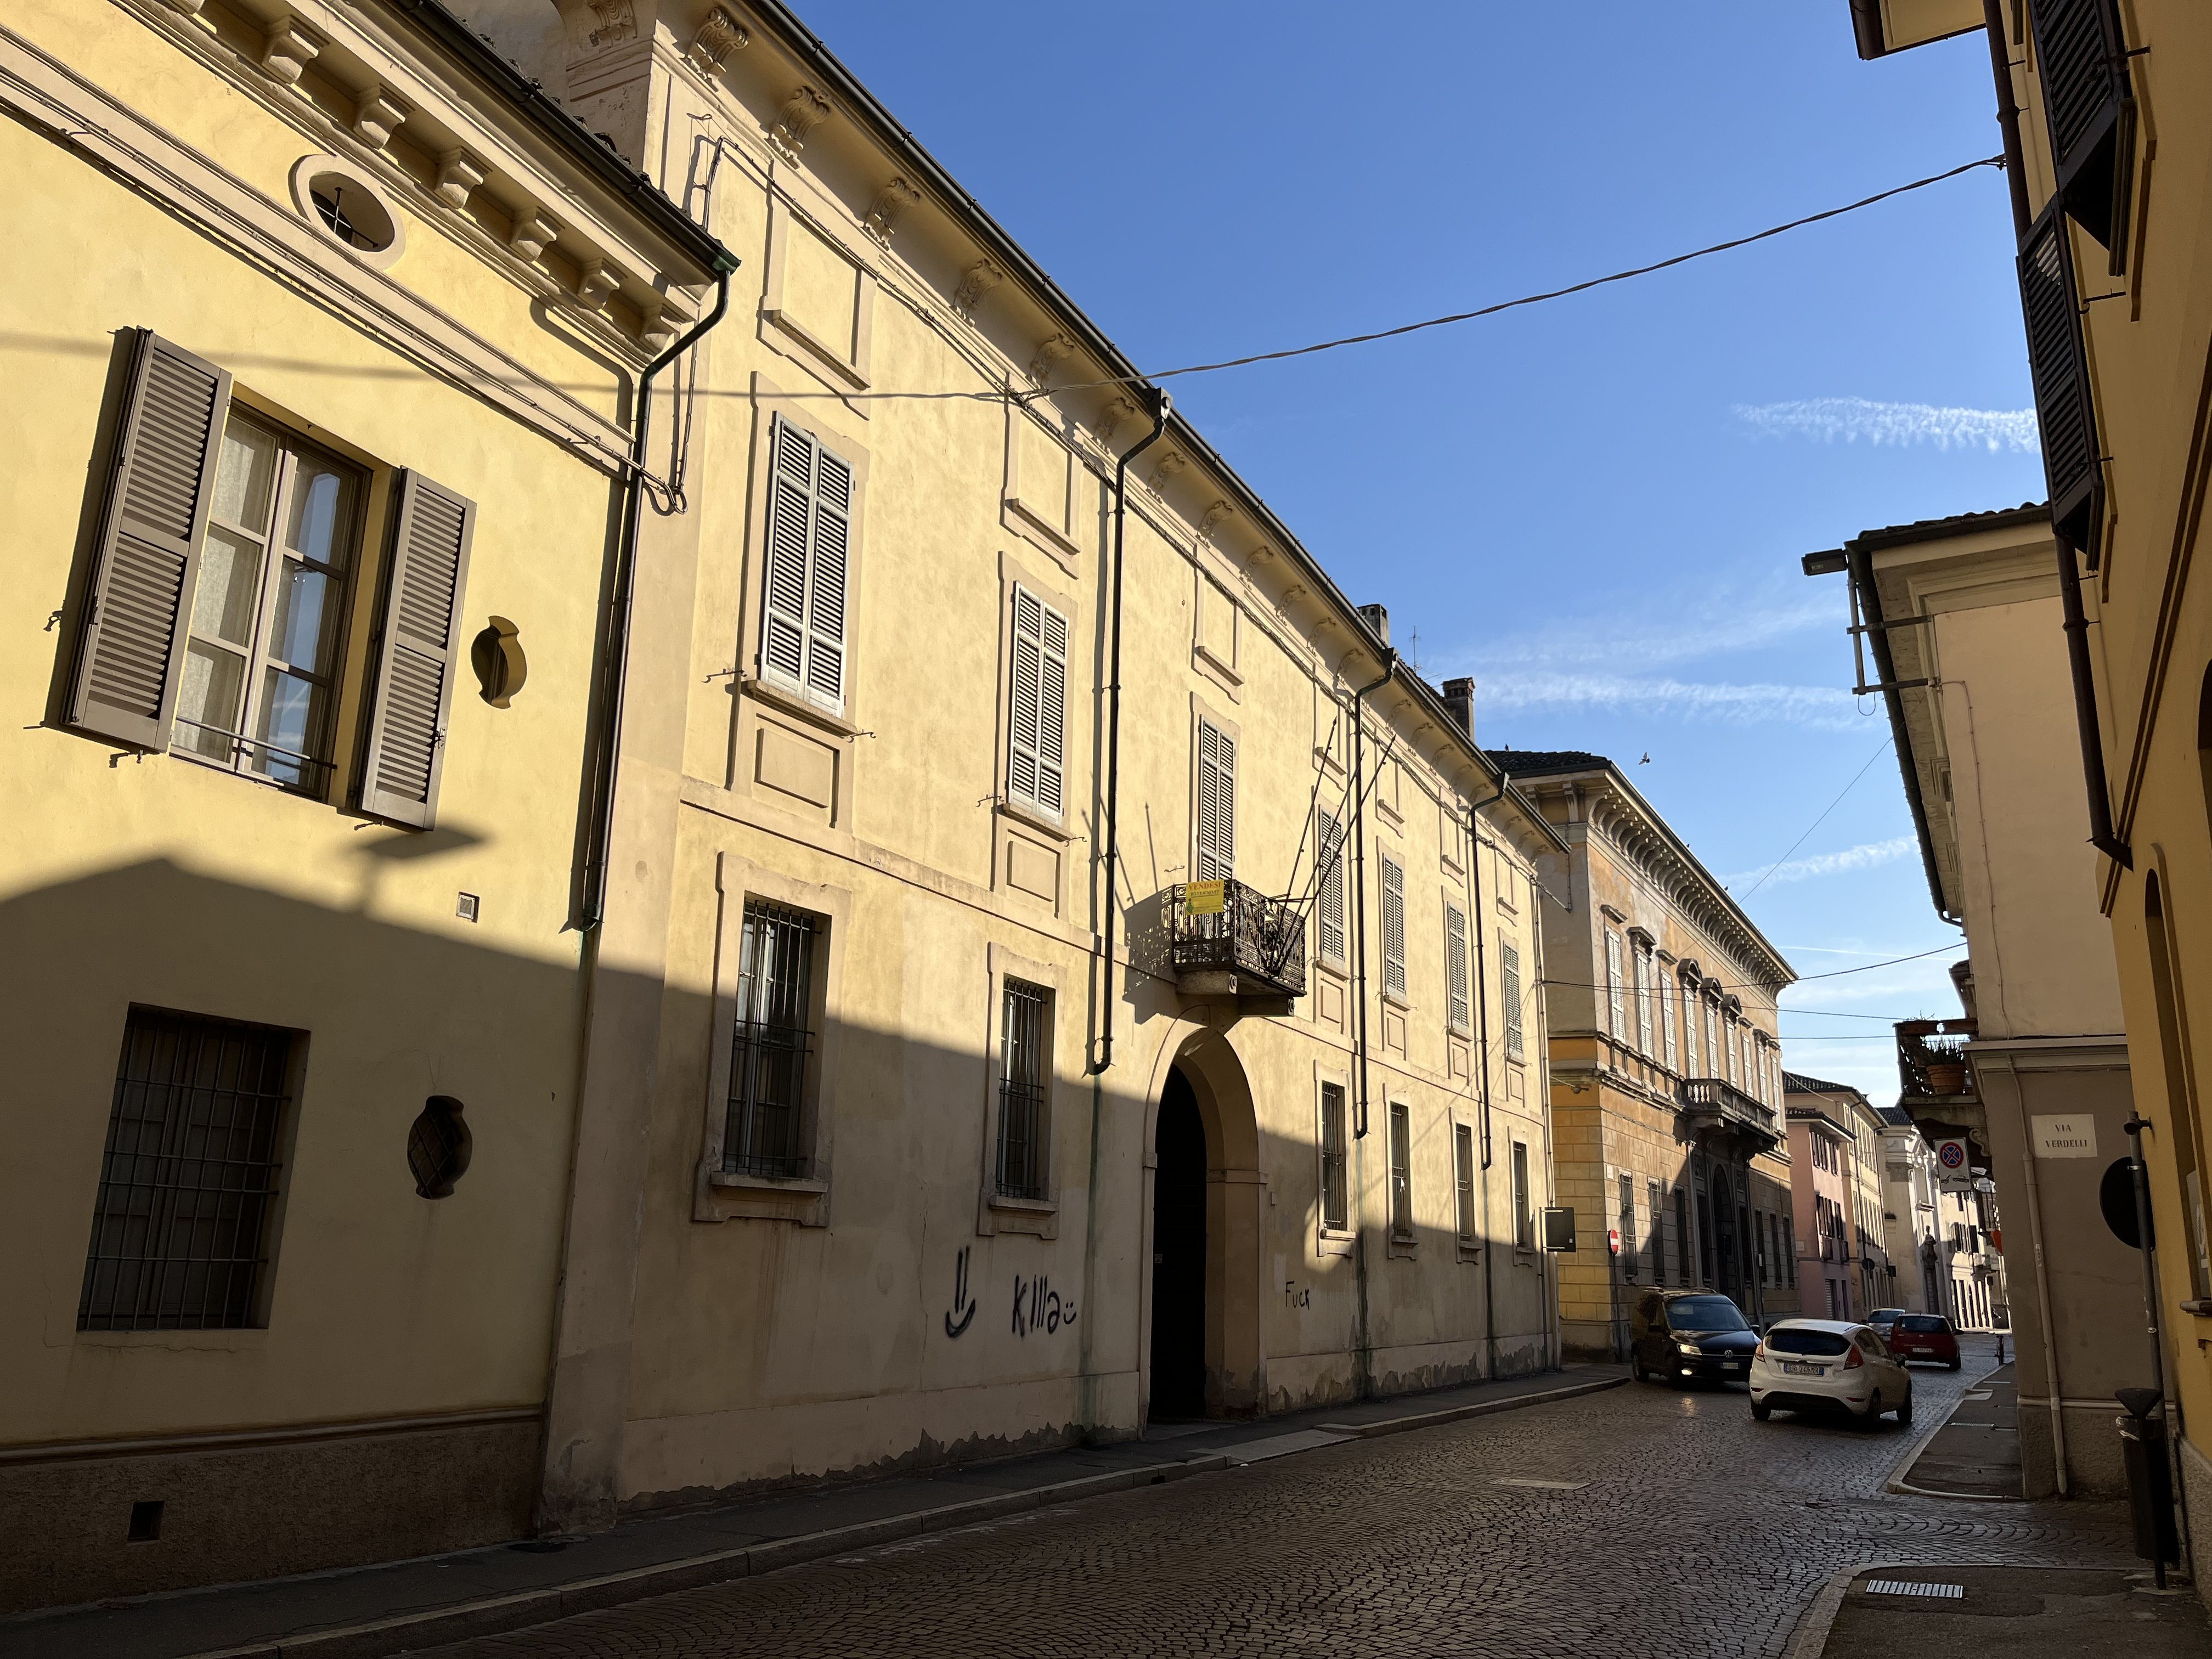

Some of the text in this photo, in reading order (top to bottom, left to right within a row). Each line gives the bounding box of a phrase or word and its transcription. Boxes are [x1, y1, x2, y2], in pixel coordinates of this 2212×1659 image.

[1188, 881, 1221, 890] VENDESI
[2055, 1124, 2072, 1132] VIA
[2045, 1139, 2087, 1148] VERDELLI
